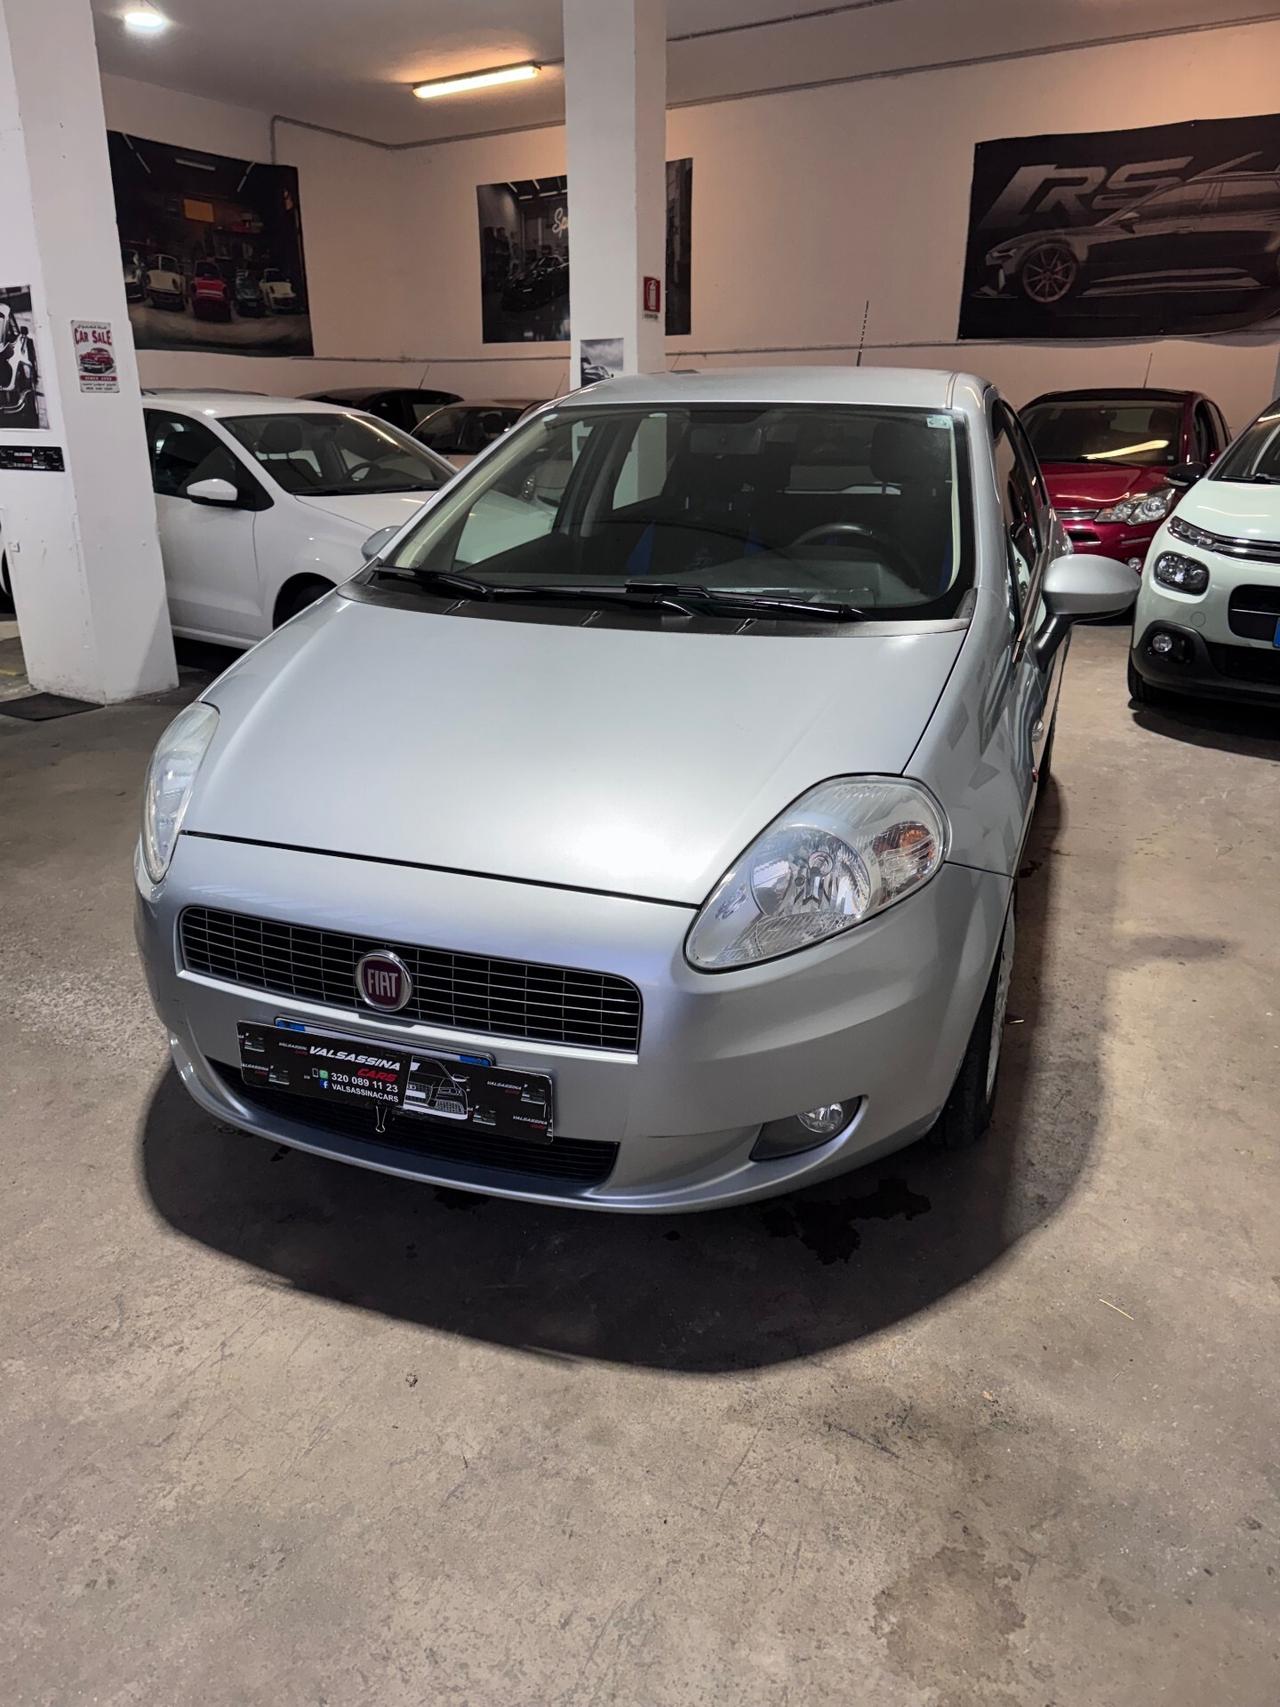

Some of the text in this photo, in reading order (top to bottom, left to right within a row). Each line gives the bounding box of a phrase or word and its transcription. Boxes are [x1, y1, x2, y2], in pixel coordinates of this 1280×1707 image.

[75, 328, 112, 345] CAR SALE
[367, 968, 399, 998] FIAT
[309, 1045, 401, 1071] VALSASSINA
[331, 1072, 399, 1093] 320 089 11 23
[356, 1068, 398, 1082] CARS
[331, 1083, 399, 1103] VALSASSINACARS
